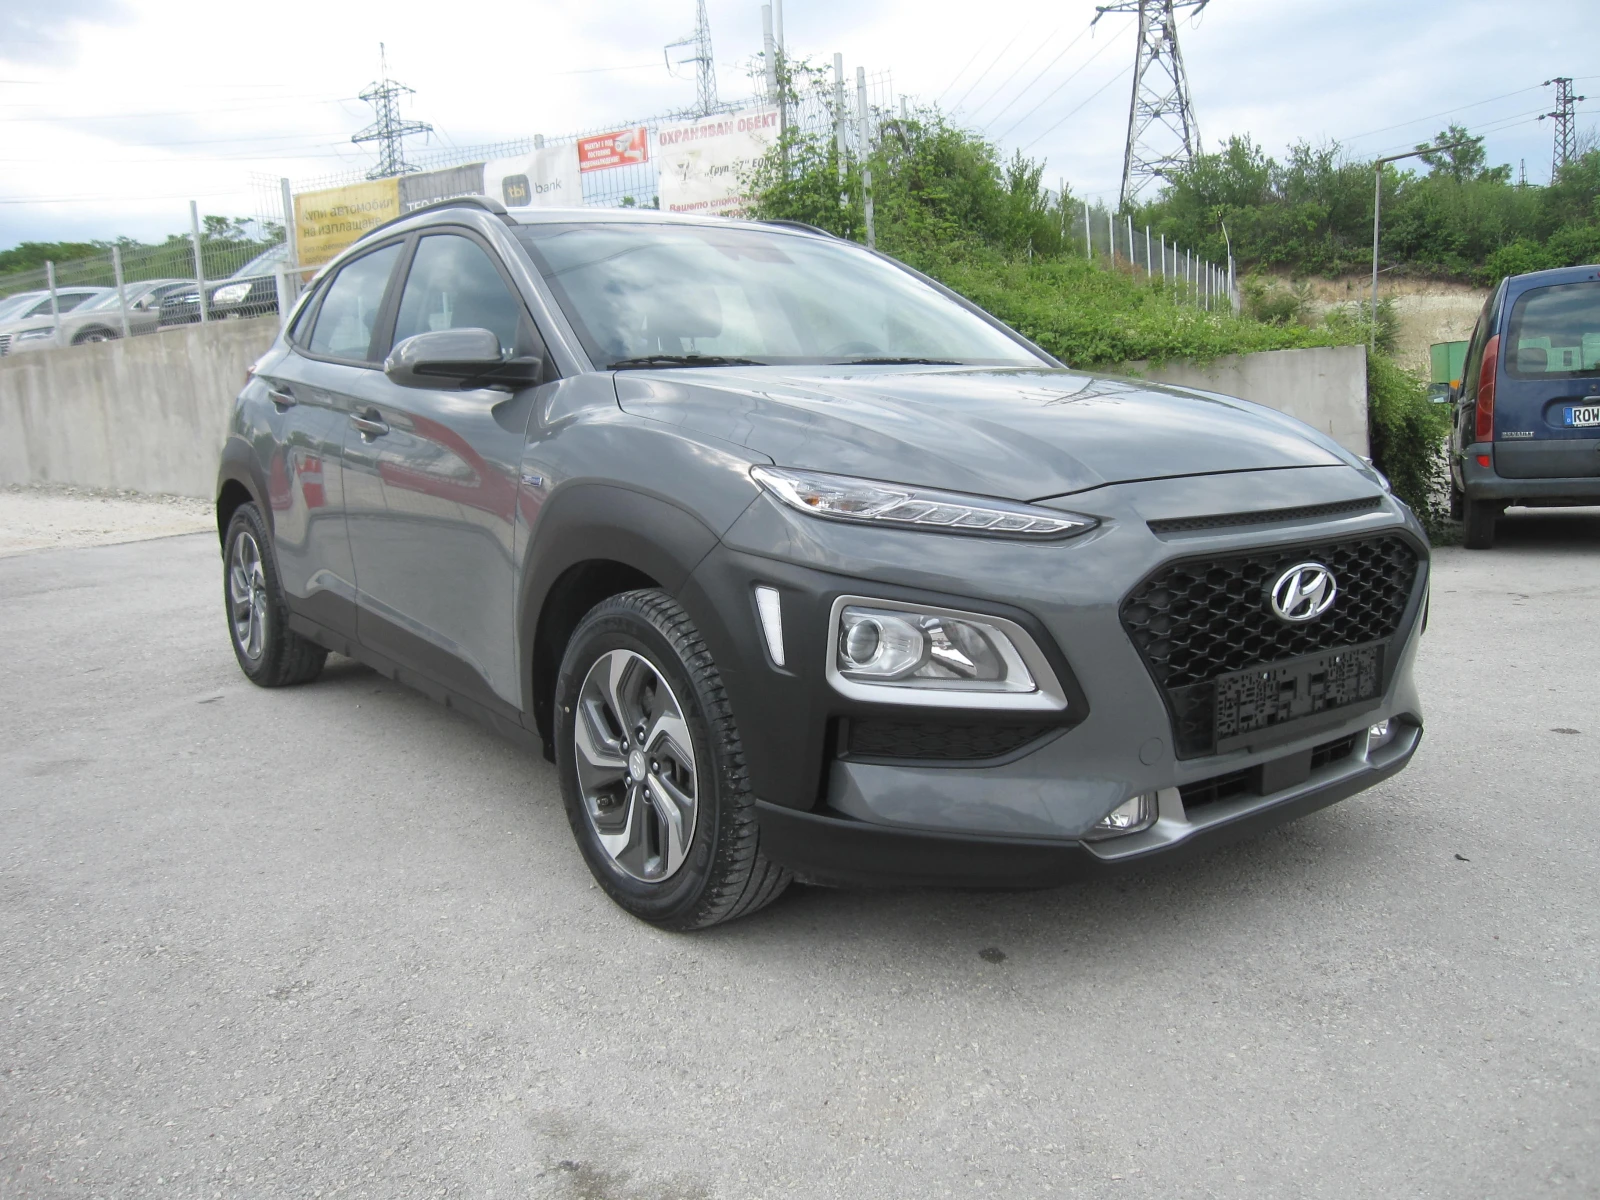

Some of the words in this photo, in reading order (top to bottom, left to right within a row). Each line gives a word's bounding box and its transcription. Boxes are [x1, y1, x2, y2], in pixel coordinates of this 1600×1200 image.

[659, 121, 734, 147] ОХРАНЯВАН
[737, 112, 778, 133] ОБЕКТ
[508, 183, 525, 198] tbi
[535, 178, 562, 194] bank
[302, 209, 327, 222] Купи
[330, 198, 393, 217] автомобил
[303, 225, 316, 238] на
[318, 216, 382, 236] изплащане
[1574, 409, 1600, 422] ROW
